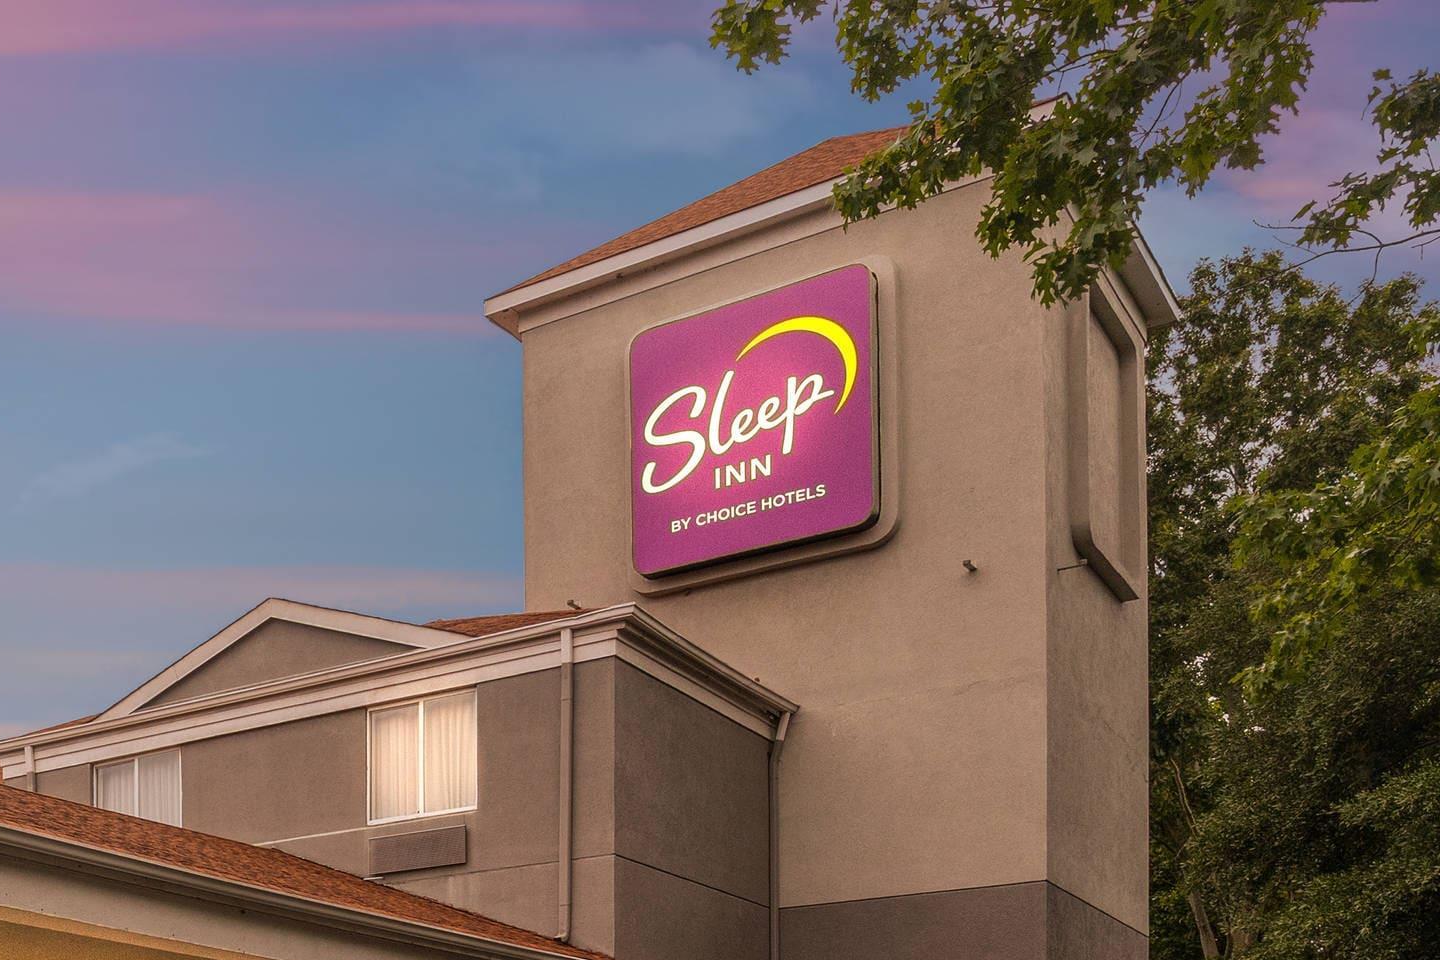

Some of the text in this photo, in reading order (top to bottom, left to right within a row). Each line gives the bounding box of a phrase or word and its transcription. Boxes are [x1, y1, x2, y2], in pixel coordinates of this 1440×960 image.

[641, 369, 835, 494] Sleep
[713, 454, 772, 489] INN
[671, 484, 827, 533] BY CHOICE HOTELS
